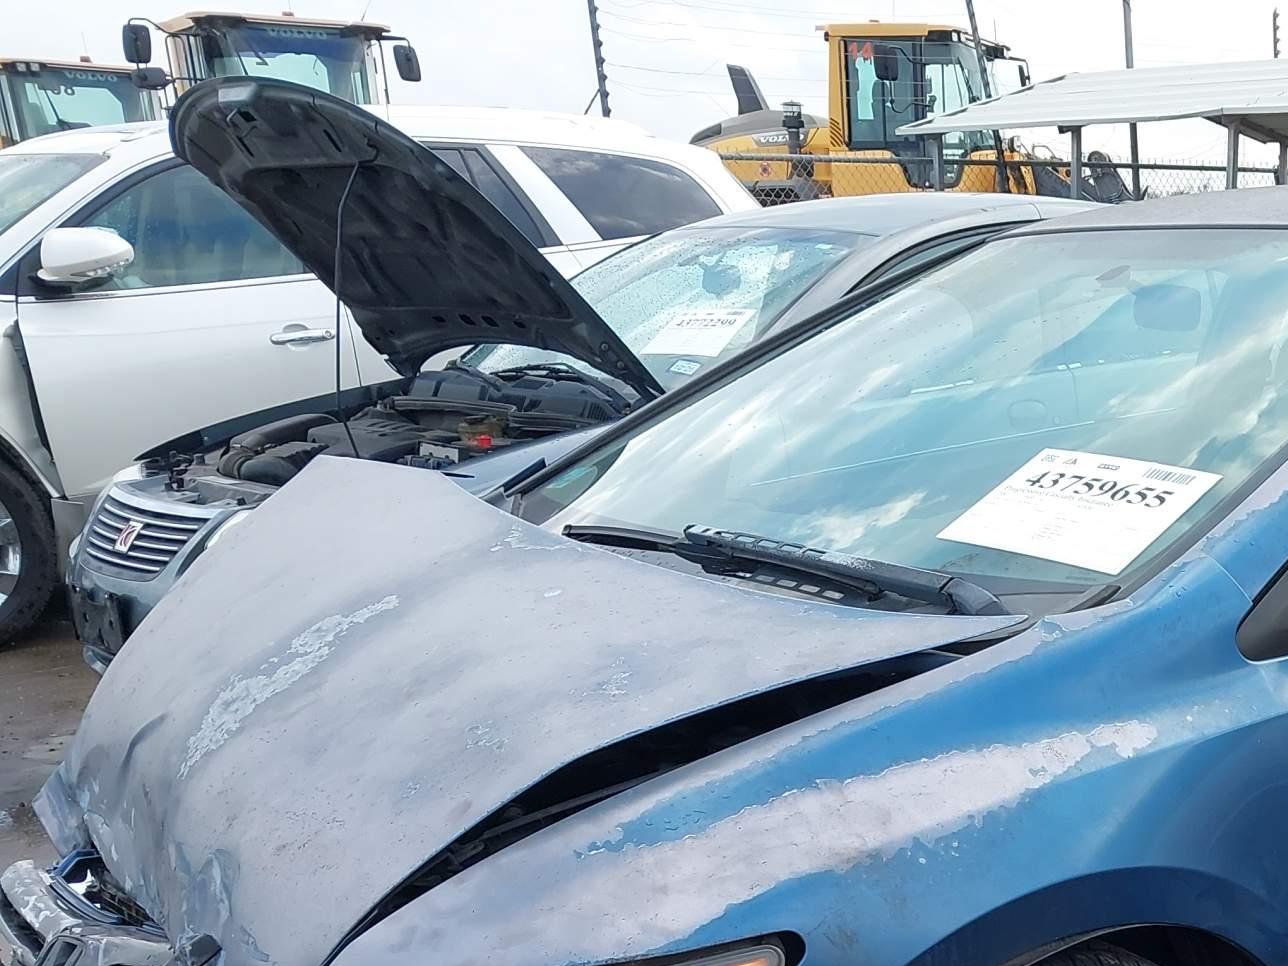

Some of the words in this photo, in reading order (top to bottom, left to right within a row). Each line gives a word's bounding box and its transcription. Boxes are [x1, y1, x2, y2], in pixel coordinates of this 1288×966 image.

[267, 28, 328, 40] VOLVO
[63, 70, 118, 82] VOLVO
[1026, 471, 1175, 508] 43759655
